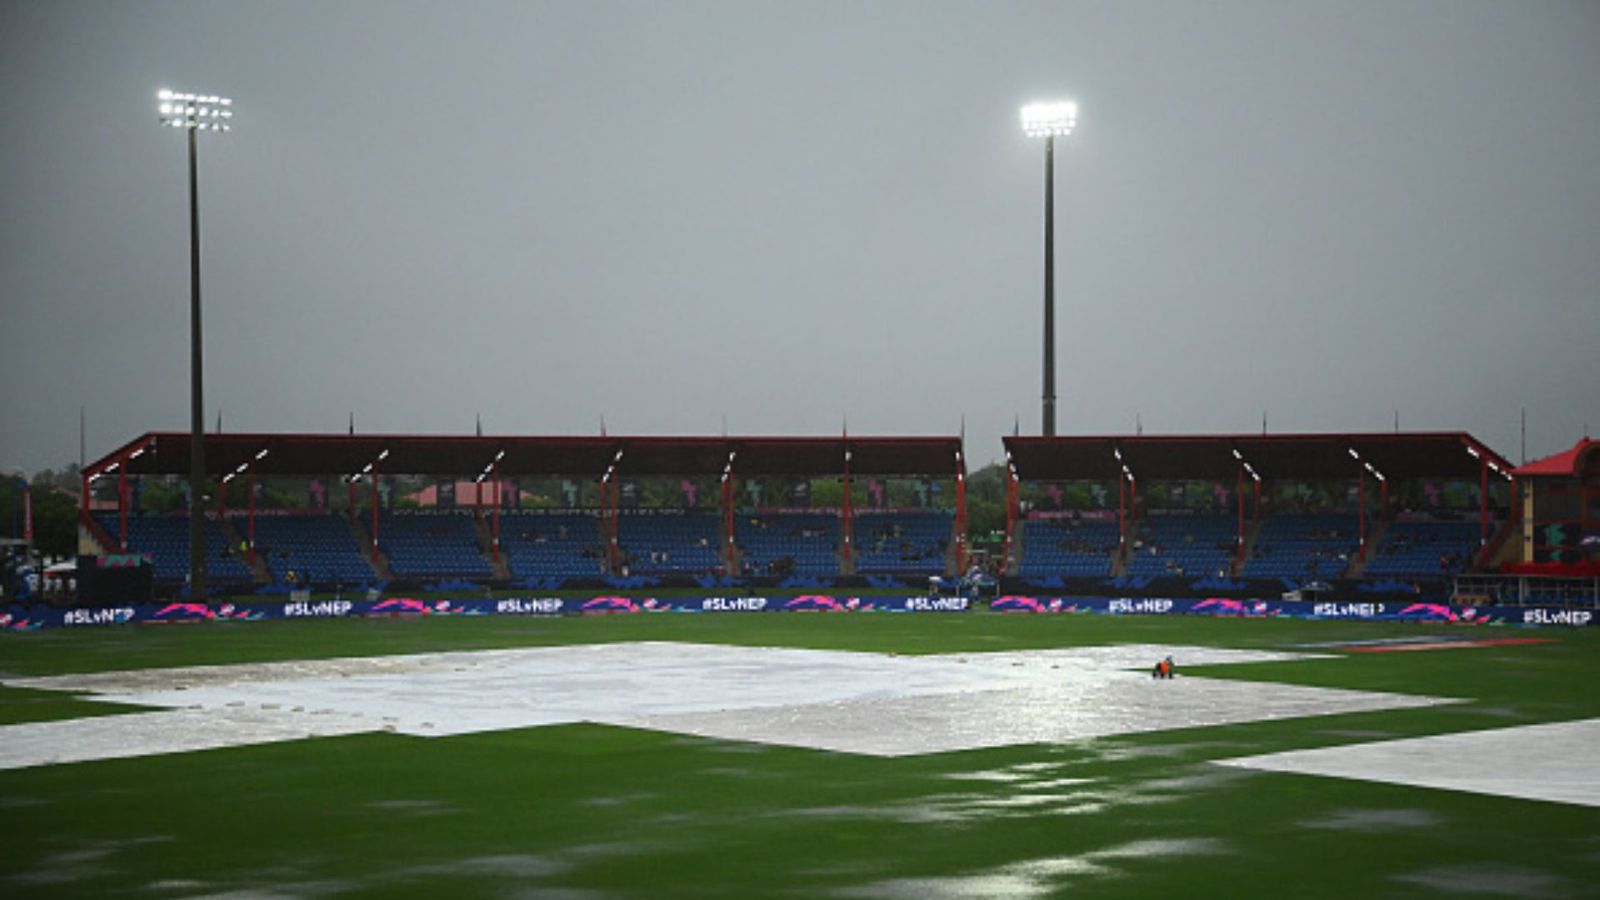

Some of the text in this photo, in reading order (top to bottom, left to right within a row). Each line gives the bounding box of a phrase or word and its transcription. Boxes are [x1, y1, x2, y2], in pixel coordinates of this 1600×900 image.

[284, 600, 353, 615] #SLvNEP
[497, 598, 564, 612] #SLvNEP
[702, 597, 768, 611] #SLvNEP
[1108, 598, 1173, 613] #SLvNEP
[1523, 608, 1593, 624] #SLvNEP
